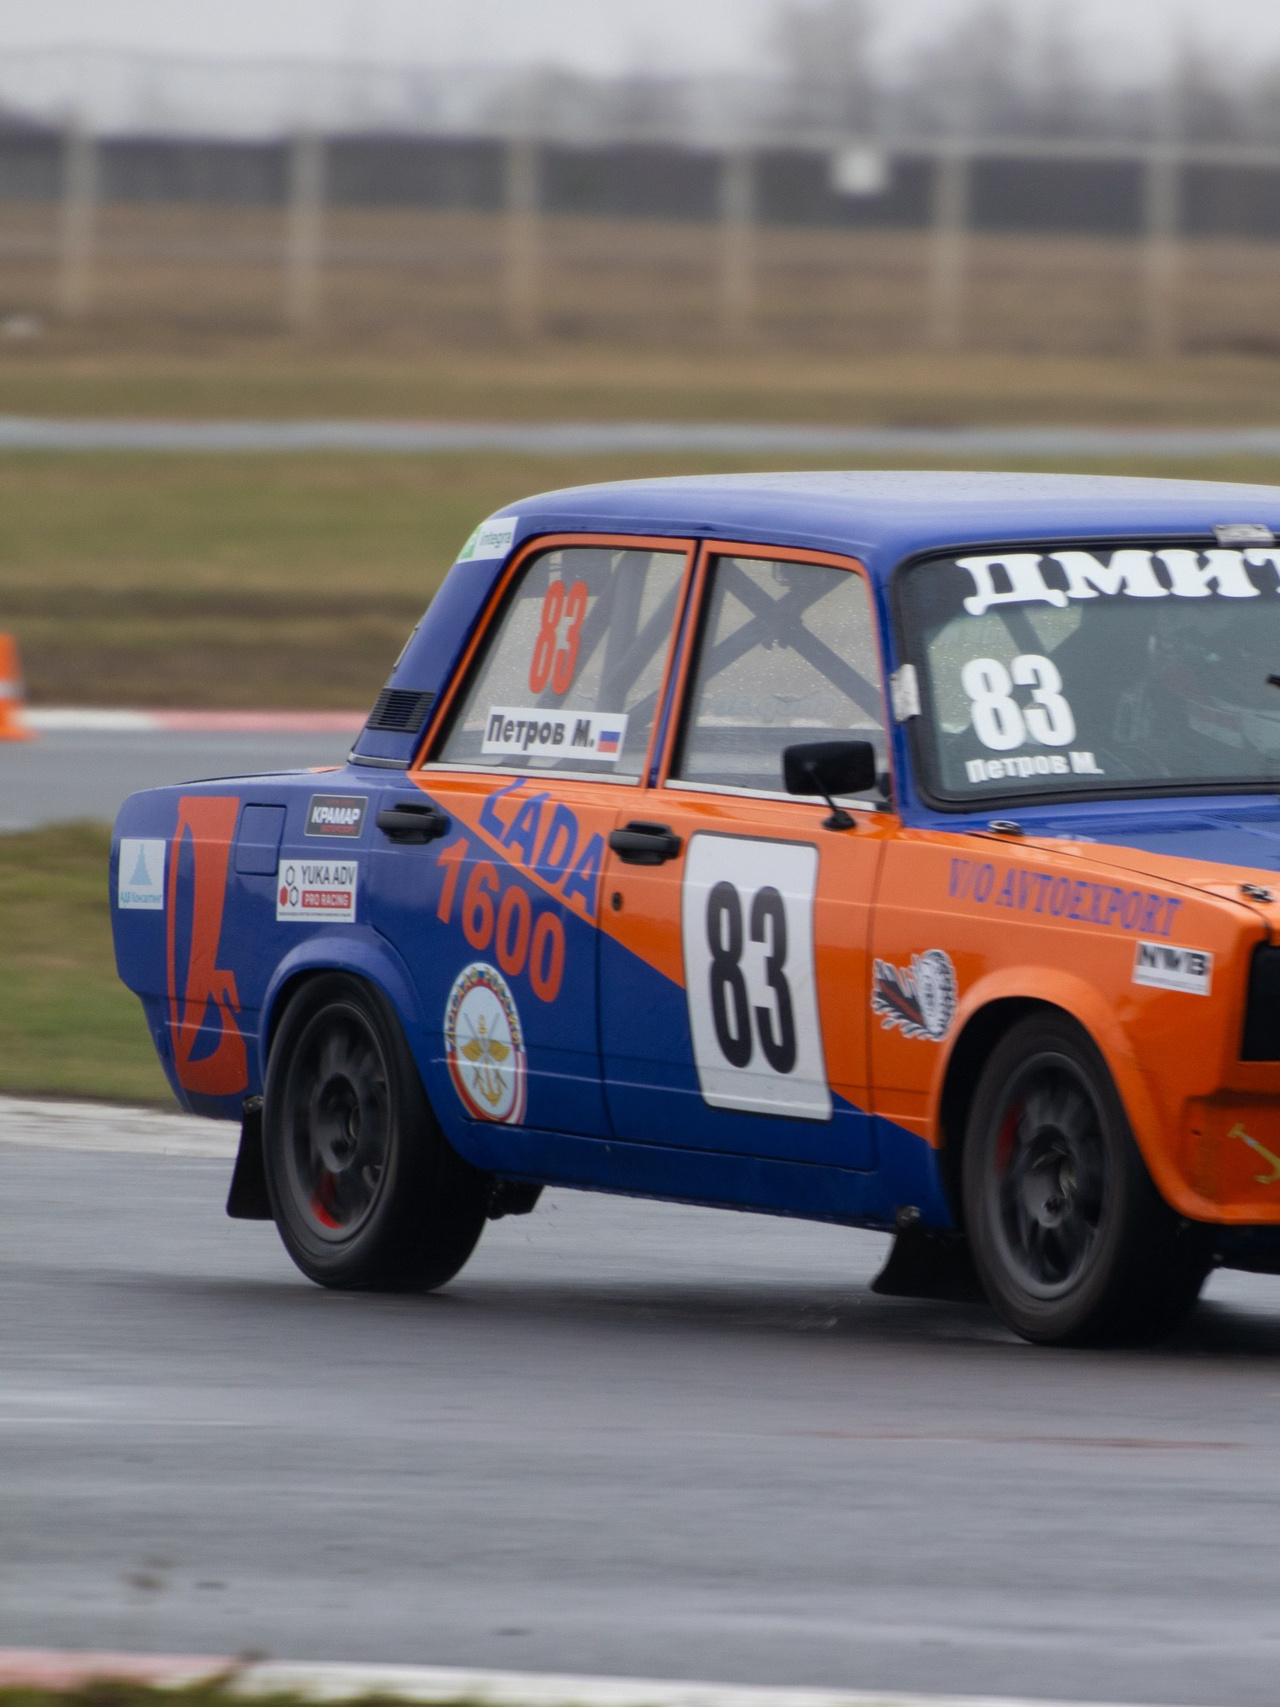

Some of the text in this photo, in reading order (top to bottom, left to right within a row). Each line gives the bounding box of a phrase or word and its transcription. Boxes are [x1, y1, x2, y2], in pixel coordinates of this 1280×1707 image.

[528, 580, 589, 695] 83
[486, 714, 596, 751] Петров М.
[961, 655, 1077, 751] 83
[965, 755, 1071, 783] Петров
[301, 865, 356, 885] YUKA ADV
[478, 777, 606, 918] LADA
[304, 892, 350, 907] PRO RACING
[436, 837, 566, 1003] 1600
[995, 867, 1183, 937] AVTOEXPORT
[706, 880, 797, 1074] 83
